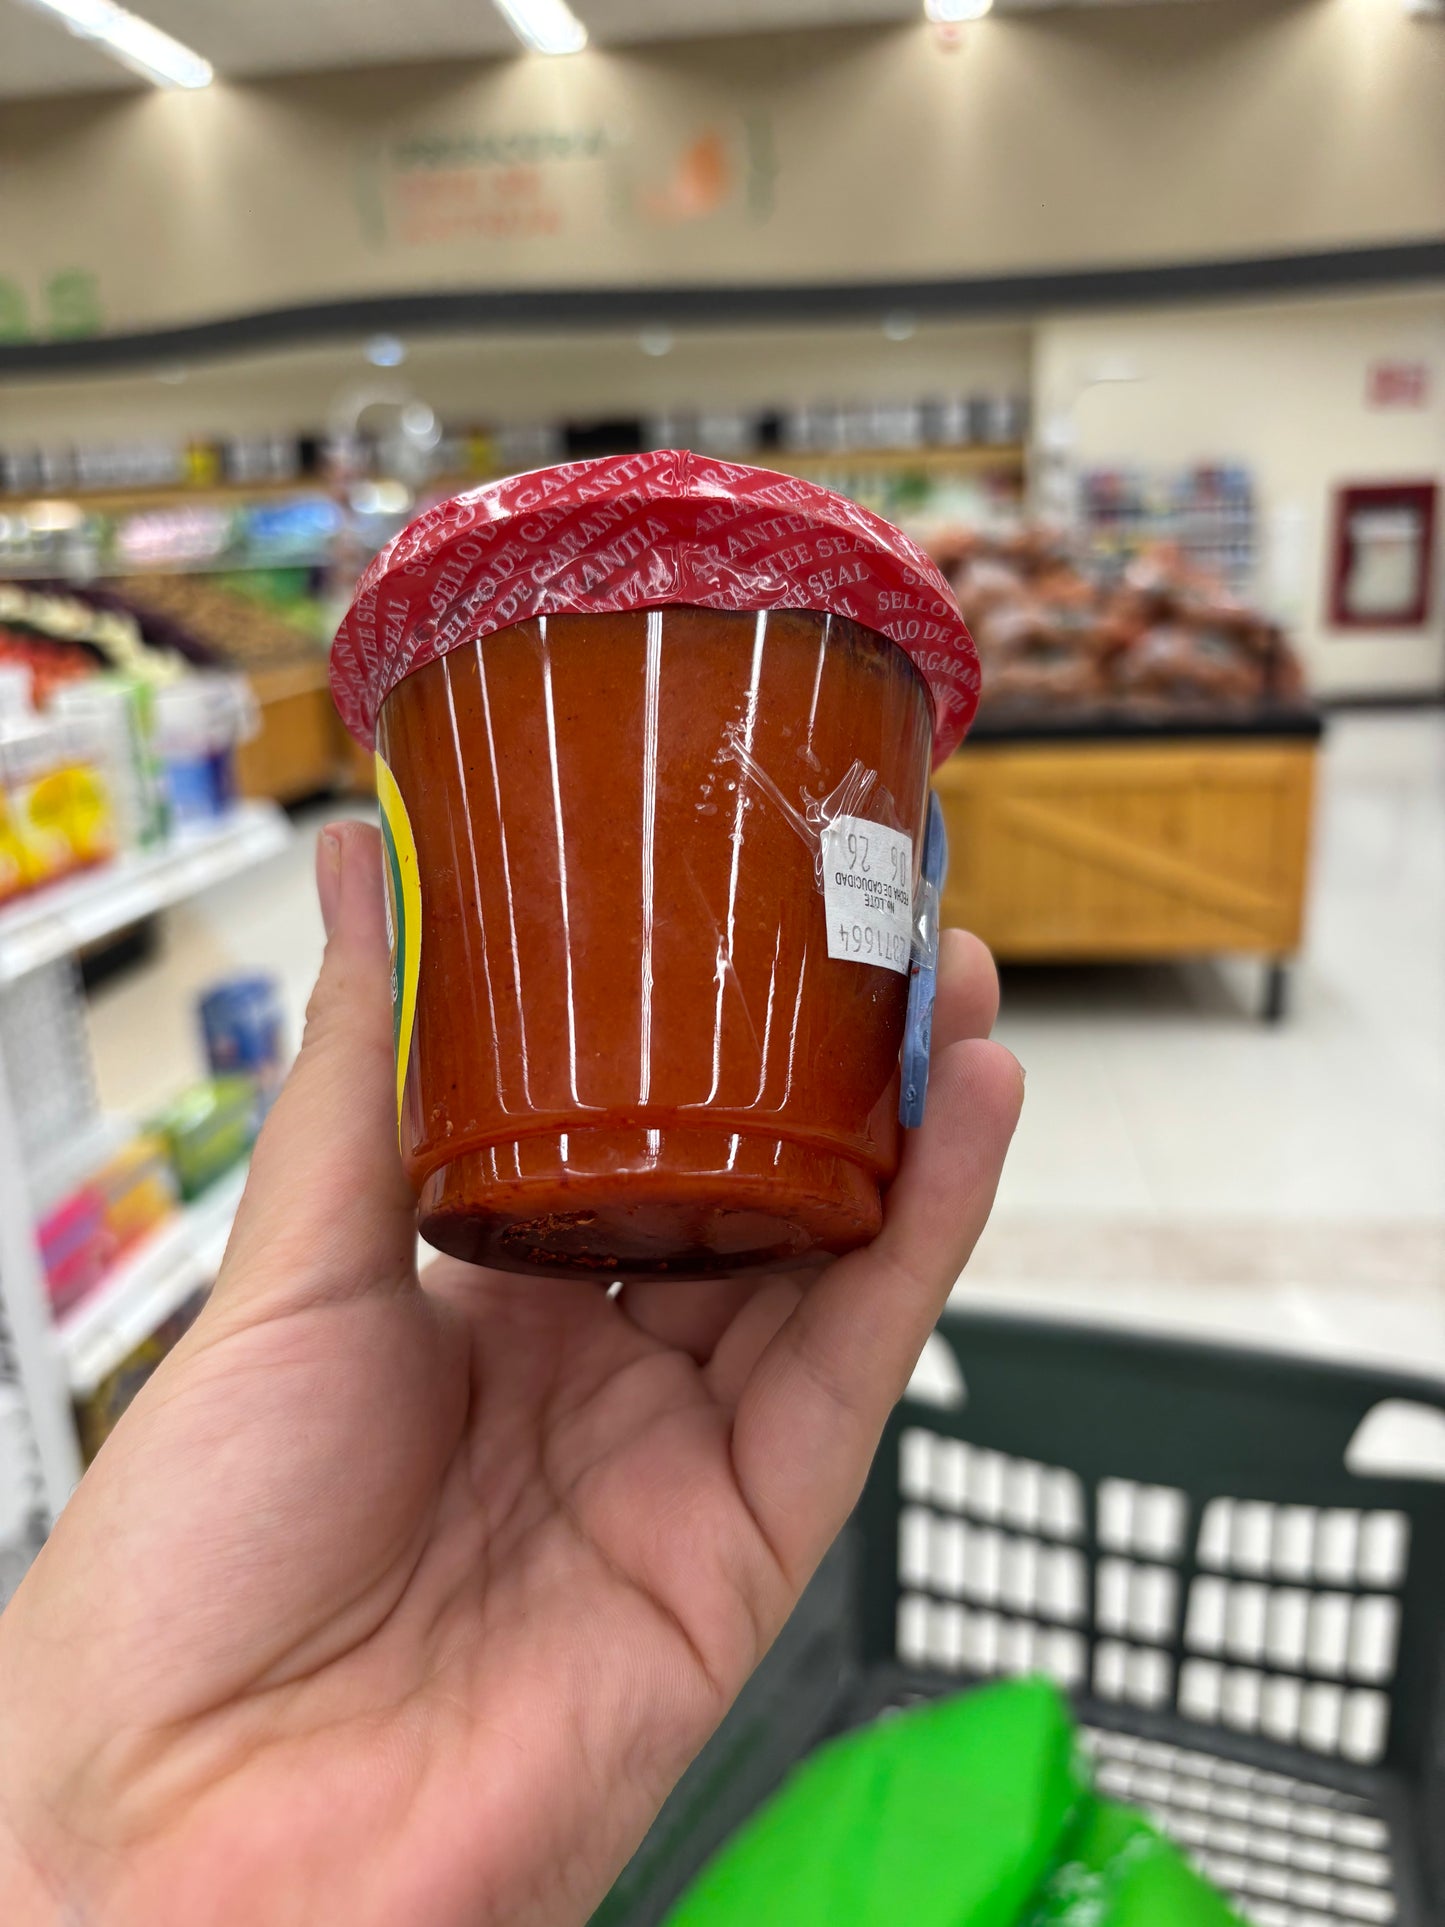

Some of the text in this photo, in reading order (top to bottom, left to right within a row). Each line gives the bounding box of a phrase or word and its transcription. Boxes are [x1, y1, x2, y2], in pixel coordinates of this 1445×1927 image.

[490, 540, 528, 579] DE
[807, 561, 870, 598] SEAL
[494, 579, 534, 621] DE
[877, 590, 948, 618] SELLO
[385, 599, 411, 659] SEAL
[922, 620, 951, 644] DE
[848, 833, 871, 873] 26
[835, 872, 909, 906] FECHA DE CADUCIDAD
[864, 893, 885, 911] LOTE
